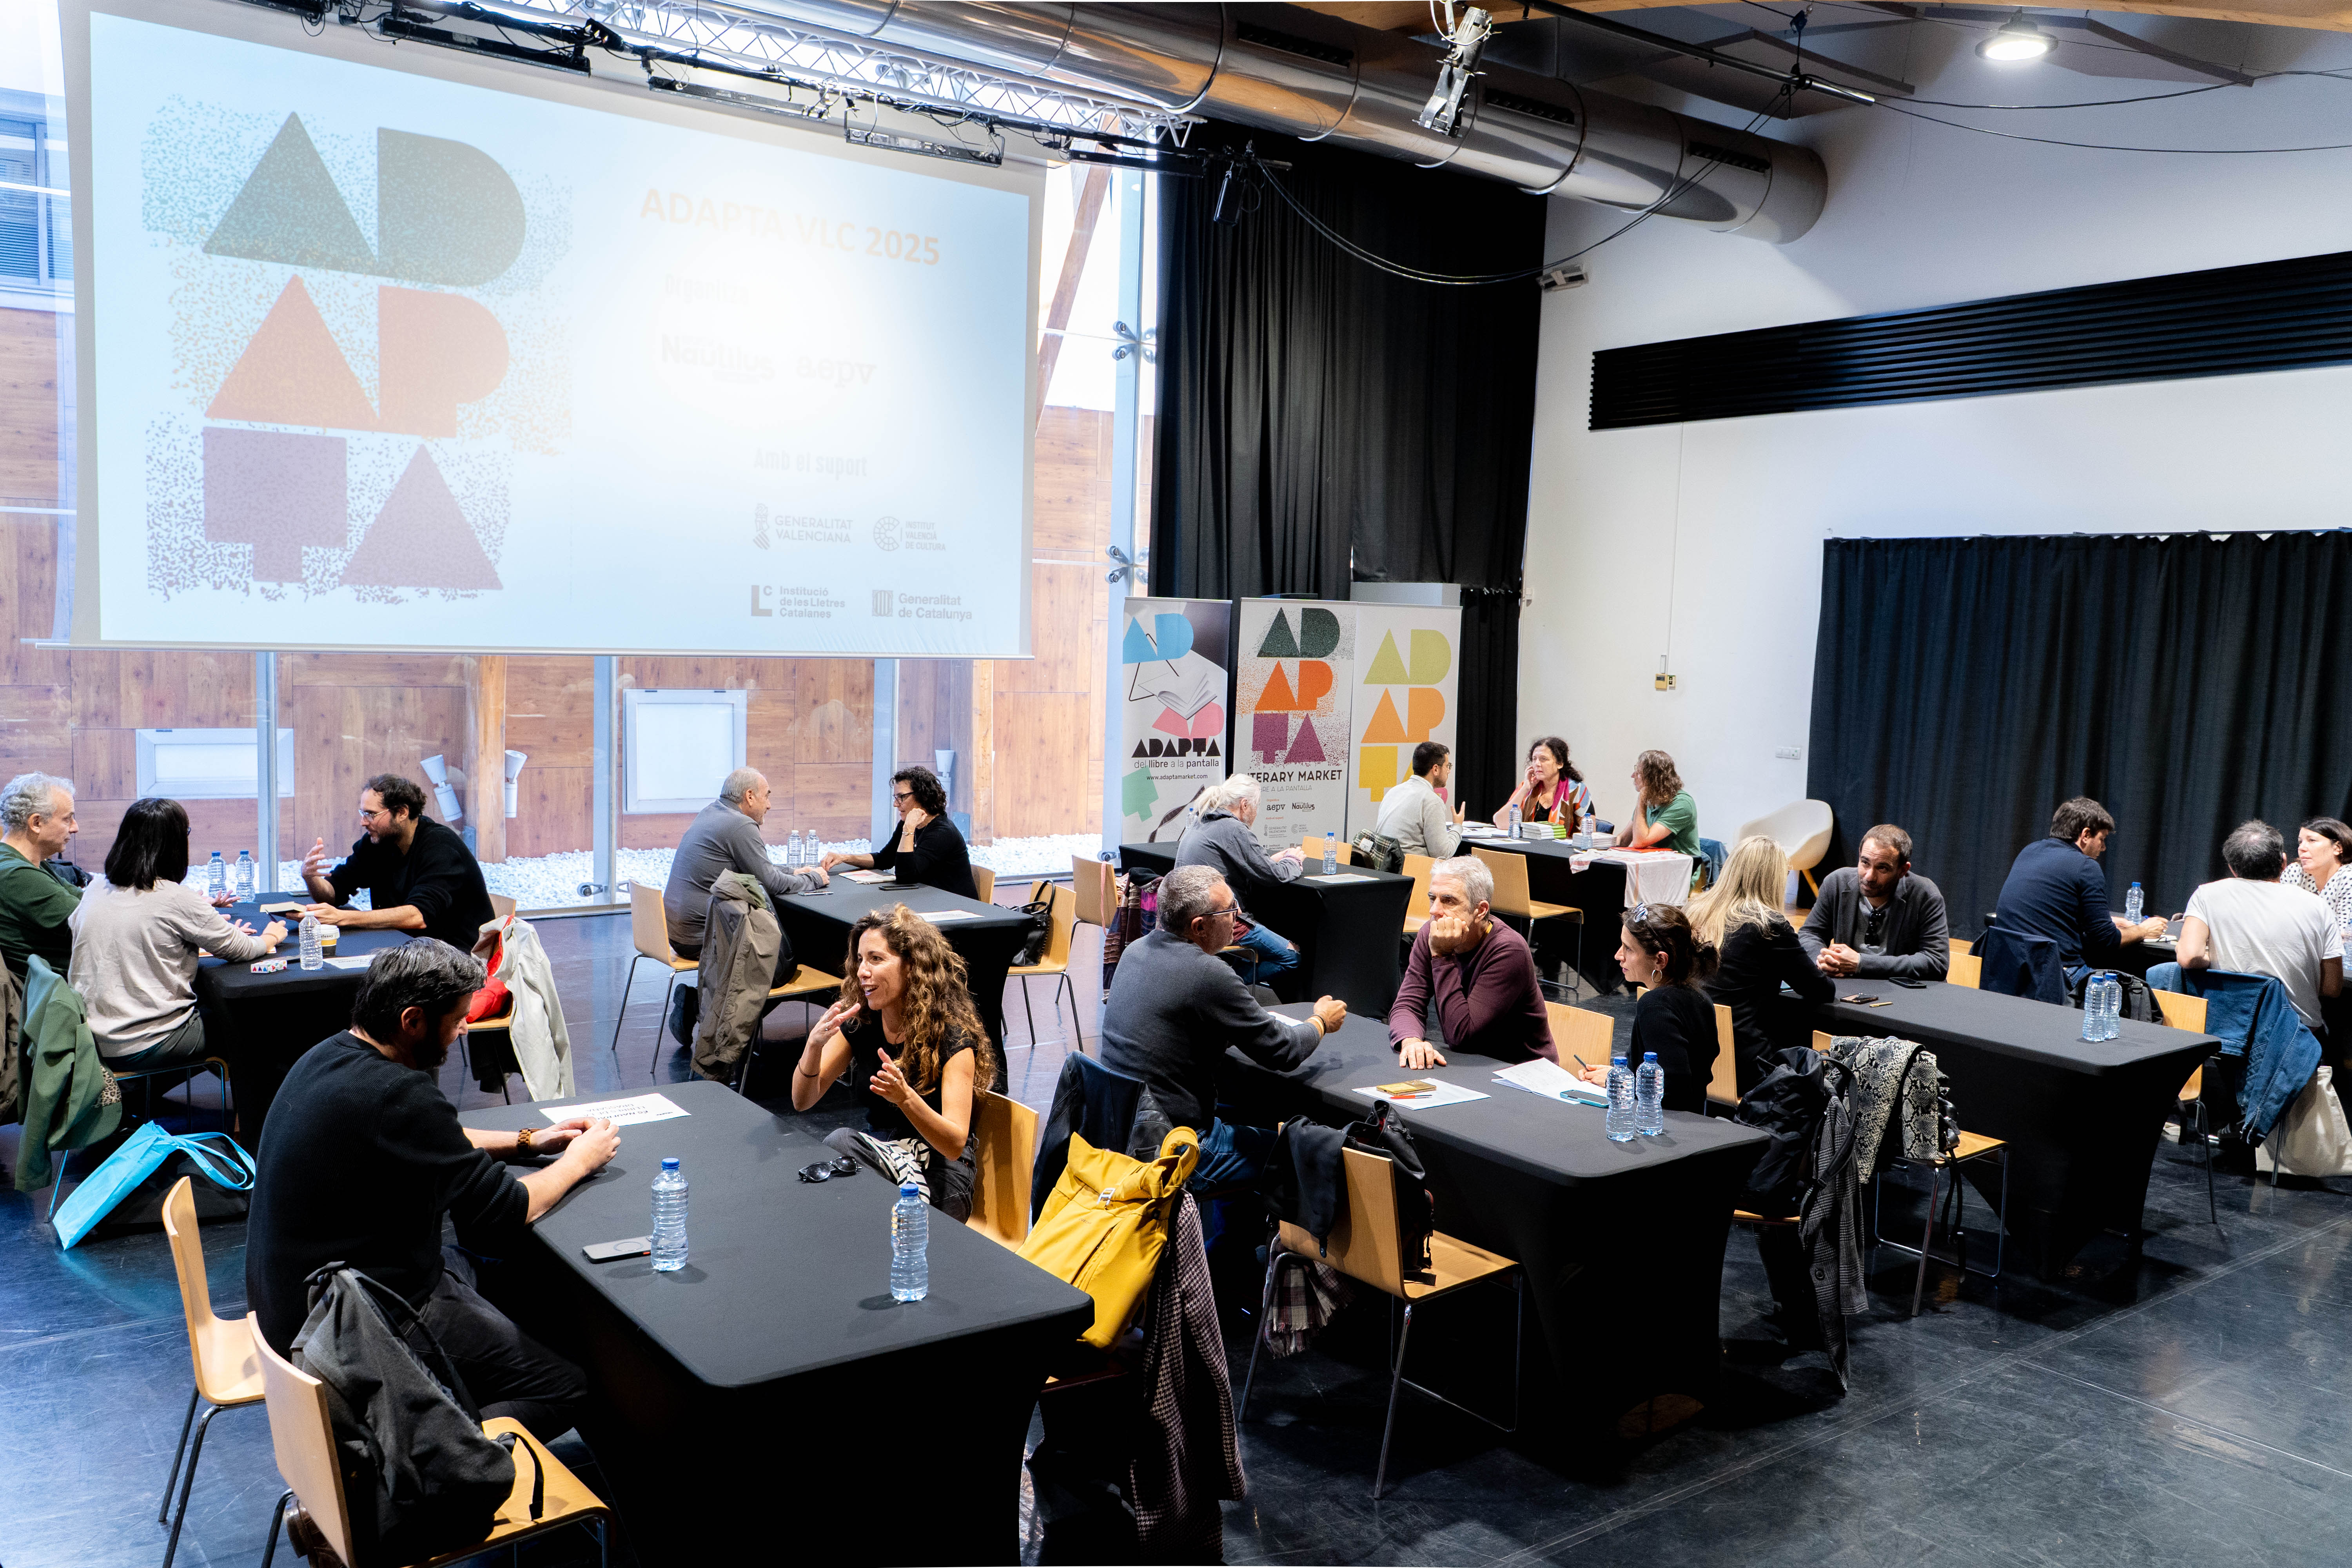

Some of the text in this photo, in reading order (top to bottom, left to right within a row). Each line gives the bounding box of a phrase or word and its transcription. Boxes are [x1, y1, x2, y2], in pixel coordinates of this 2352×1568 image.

[640, 188, 940, 265] ADAPTA VLC 2025
[662, 334, 877, 388] Nautilus aepv
[754, 448, 867, 481] Amb el suport
[775, 515, 853, 530] GENERALITAT
[906, 521, 935, 530] INSTITUT
[776, 529, 851, 544] VALENCIANA
[906, 530, 937, 541] VALENCIÀ
[916, 542, 946, 552] CULTURA
[780, 586, 829, 597] Institució
[779, 597, 846, 608] de les Lletres
[899, 593, 962, 606] Generalitat
[780, 608, 832, 619] Catalanes
[898, 608, 973, 622] de Catalunya
[1131, 738, 1221, 758] ADAPTA
[1134, 760, 1146, 768] del
[1149, 760, 1168, 768] llibre
[1187, 759, 1219, 769] pantalla
[1298, 770, 1342, 781] MARKET
